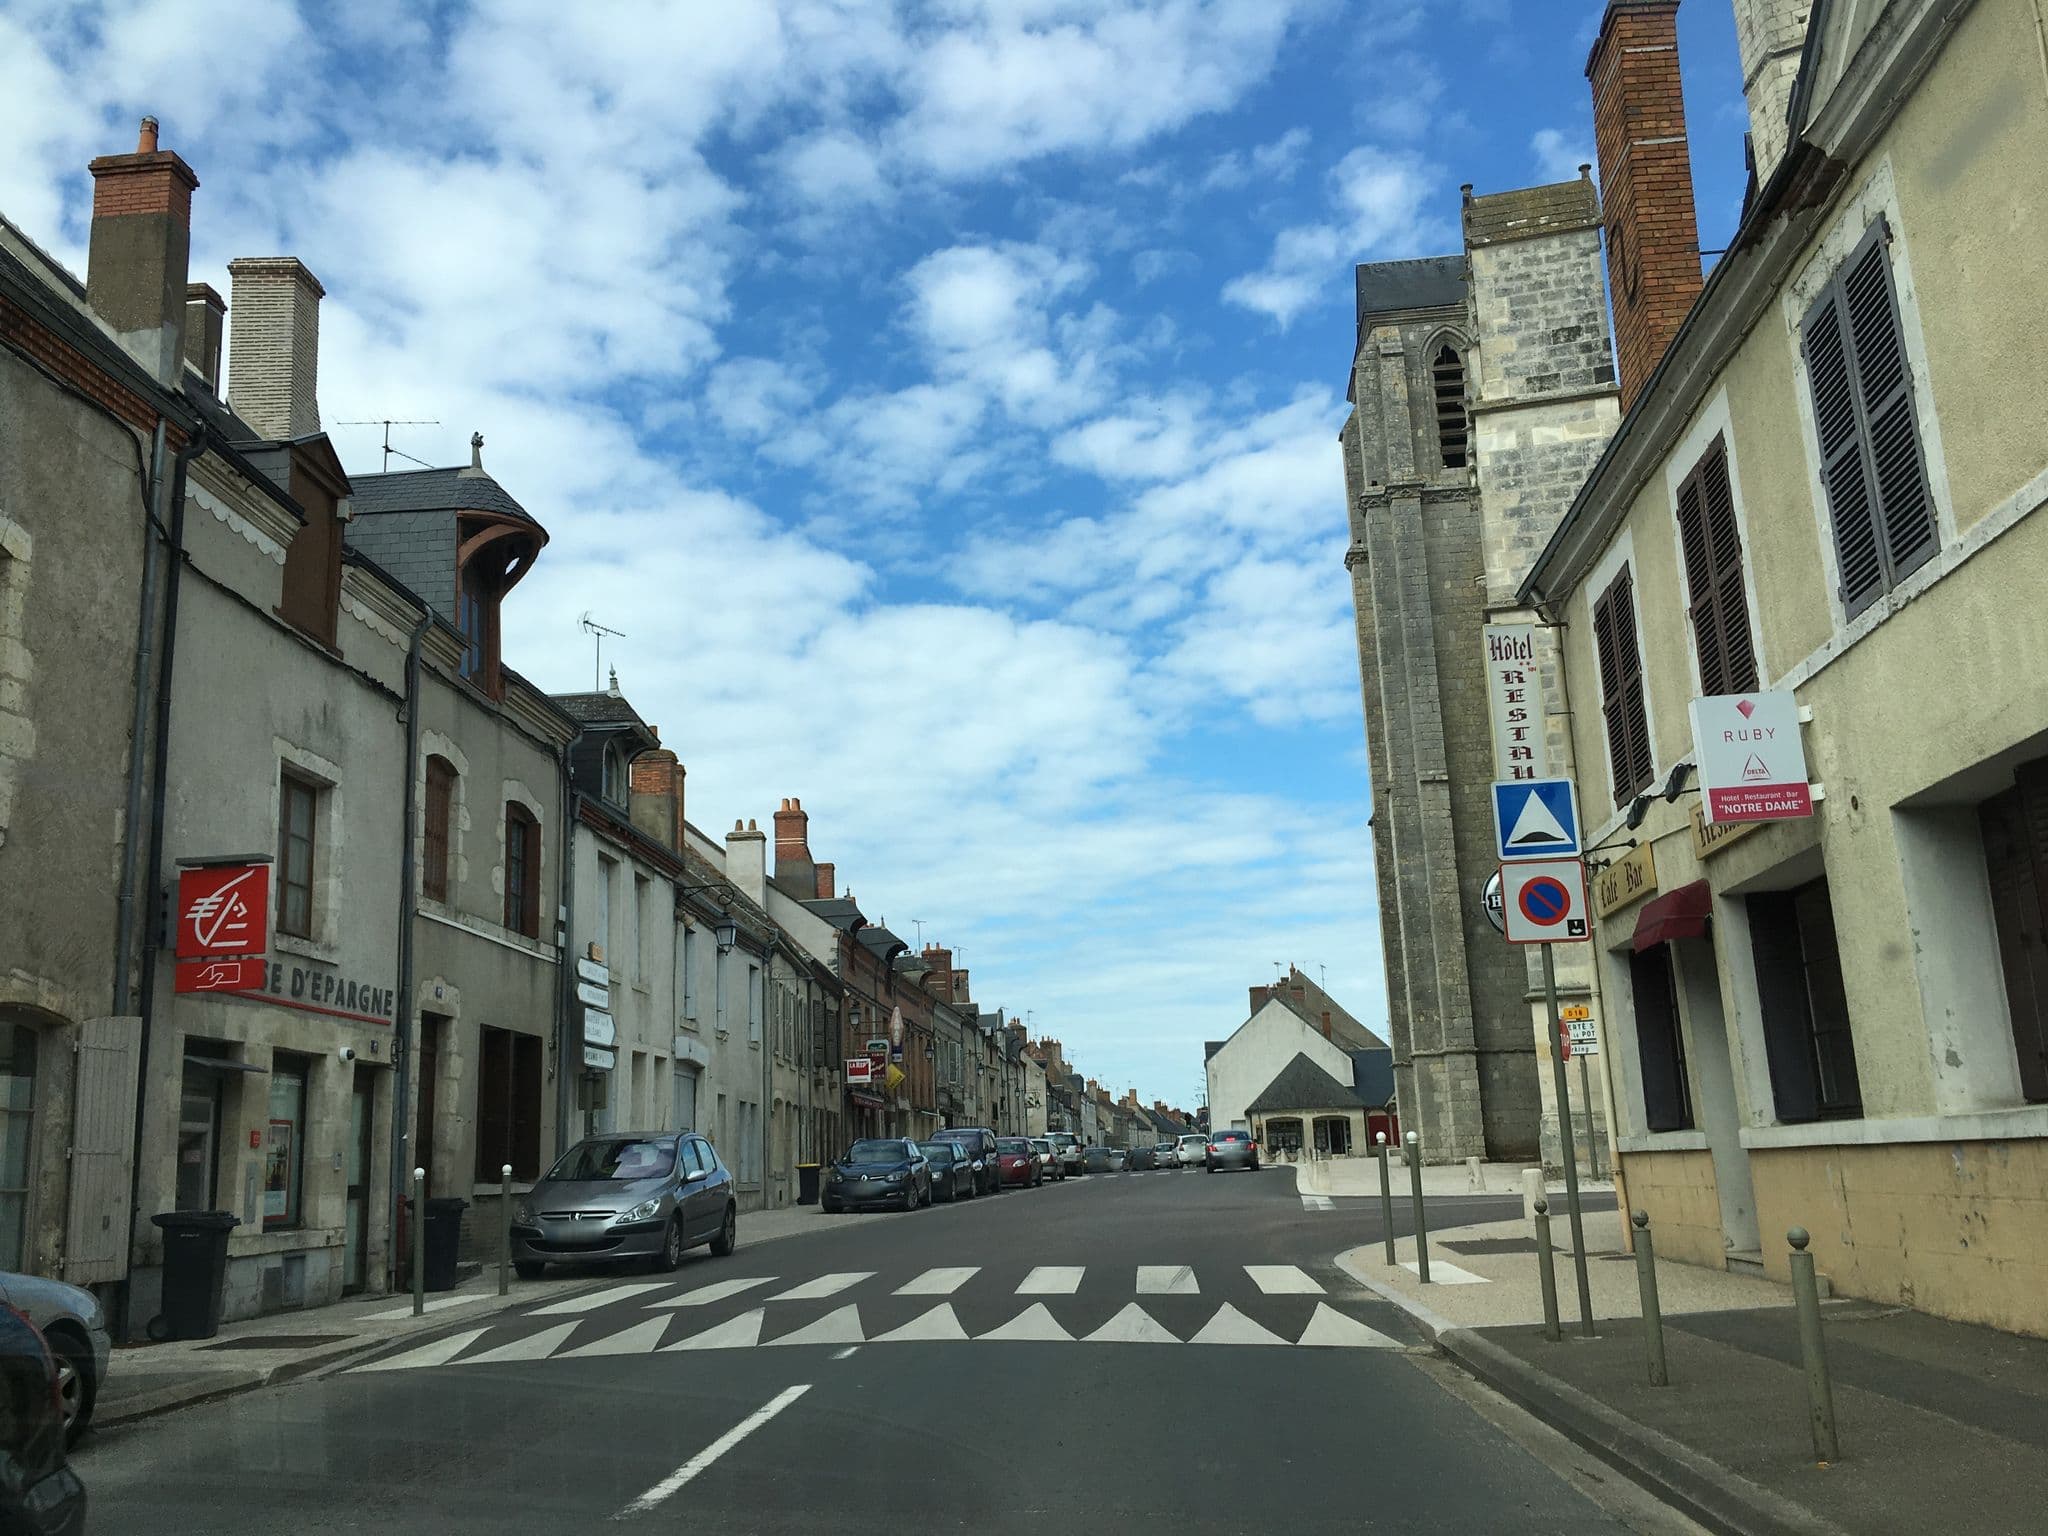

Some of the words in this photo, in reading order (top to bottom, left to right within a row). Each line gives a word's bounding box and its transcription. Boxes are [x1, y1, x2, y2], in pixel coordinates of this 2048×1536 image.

[1488, 633, 1533, 661] Hôtel
[1724, 727, 1776, 742] RUBY
[1719, 803, 1763, 814] "NOTRE
[1765, 800, 1804, 811] DAME"
[1721, 794, 1740, 802] Hotel
[1744, 792, 1781, 801] Restaurant
[1600, 871, 1619, 908] Café
[1624, 861, 1643, 894] Bar
[291, 967, 394, 1016] D'EPARGNE
